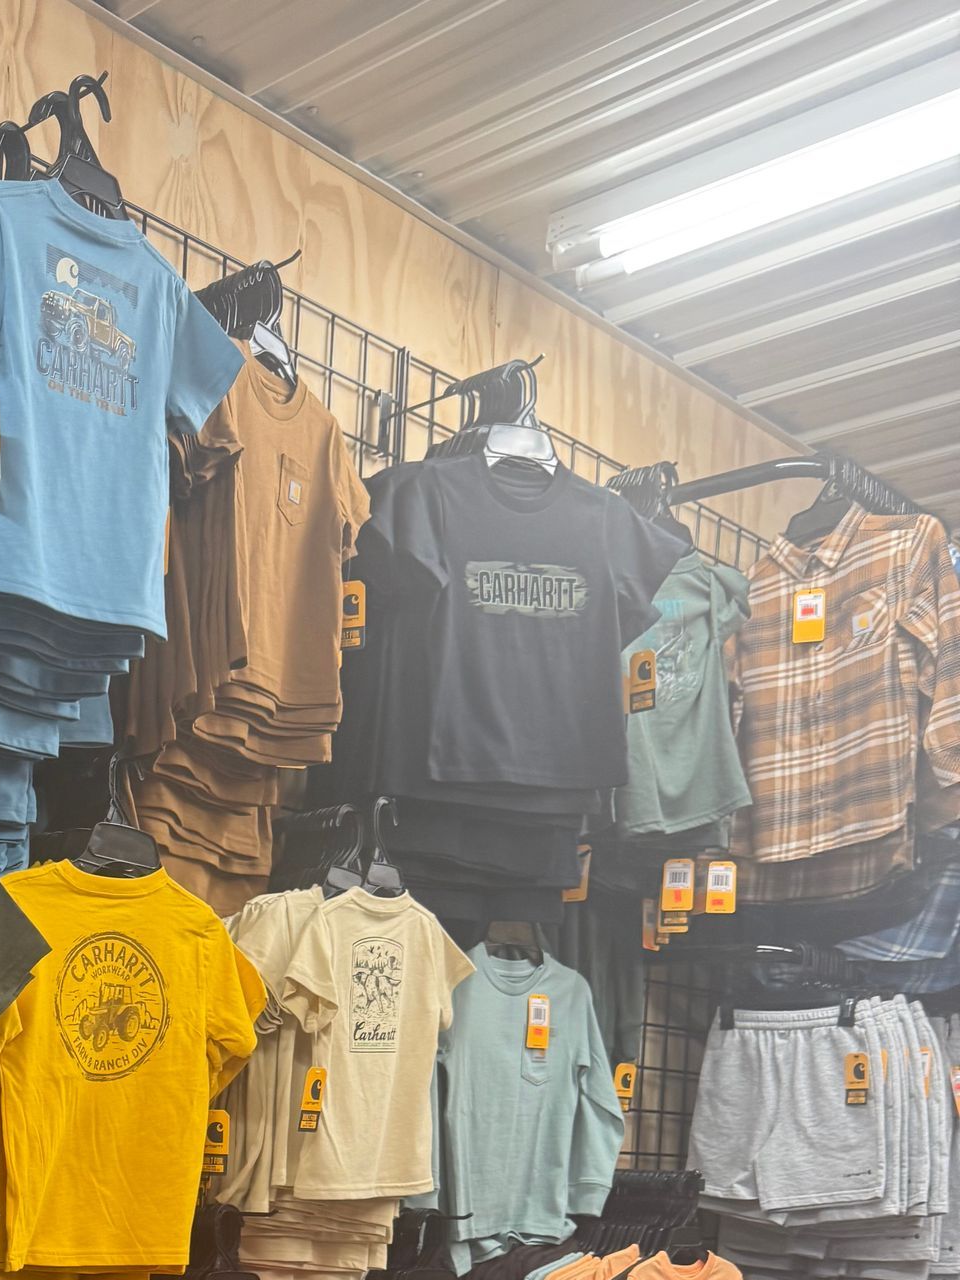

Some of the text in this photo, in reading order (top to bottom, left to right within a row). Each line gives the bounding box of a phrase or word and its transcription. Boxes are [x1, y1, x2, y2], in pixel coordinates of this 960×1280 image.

[36, 338, 139, 410] CARHARTT
[478, 570, 577, 610] CARHARTT
[71, 943, 155, 987] CARHARTT
[91, 965, 131, 982] WORKWEAR
[353, 1021, 396, 1041] Carhartt
[73, 1037, 88, 1063] FARM
[93, 1056, 129, 1071] RANCH
[132, 1038, 147, 1058] DIV
